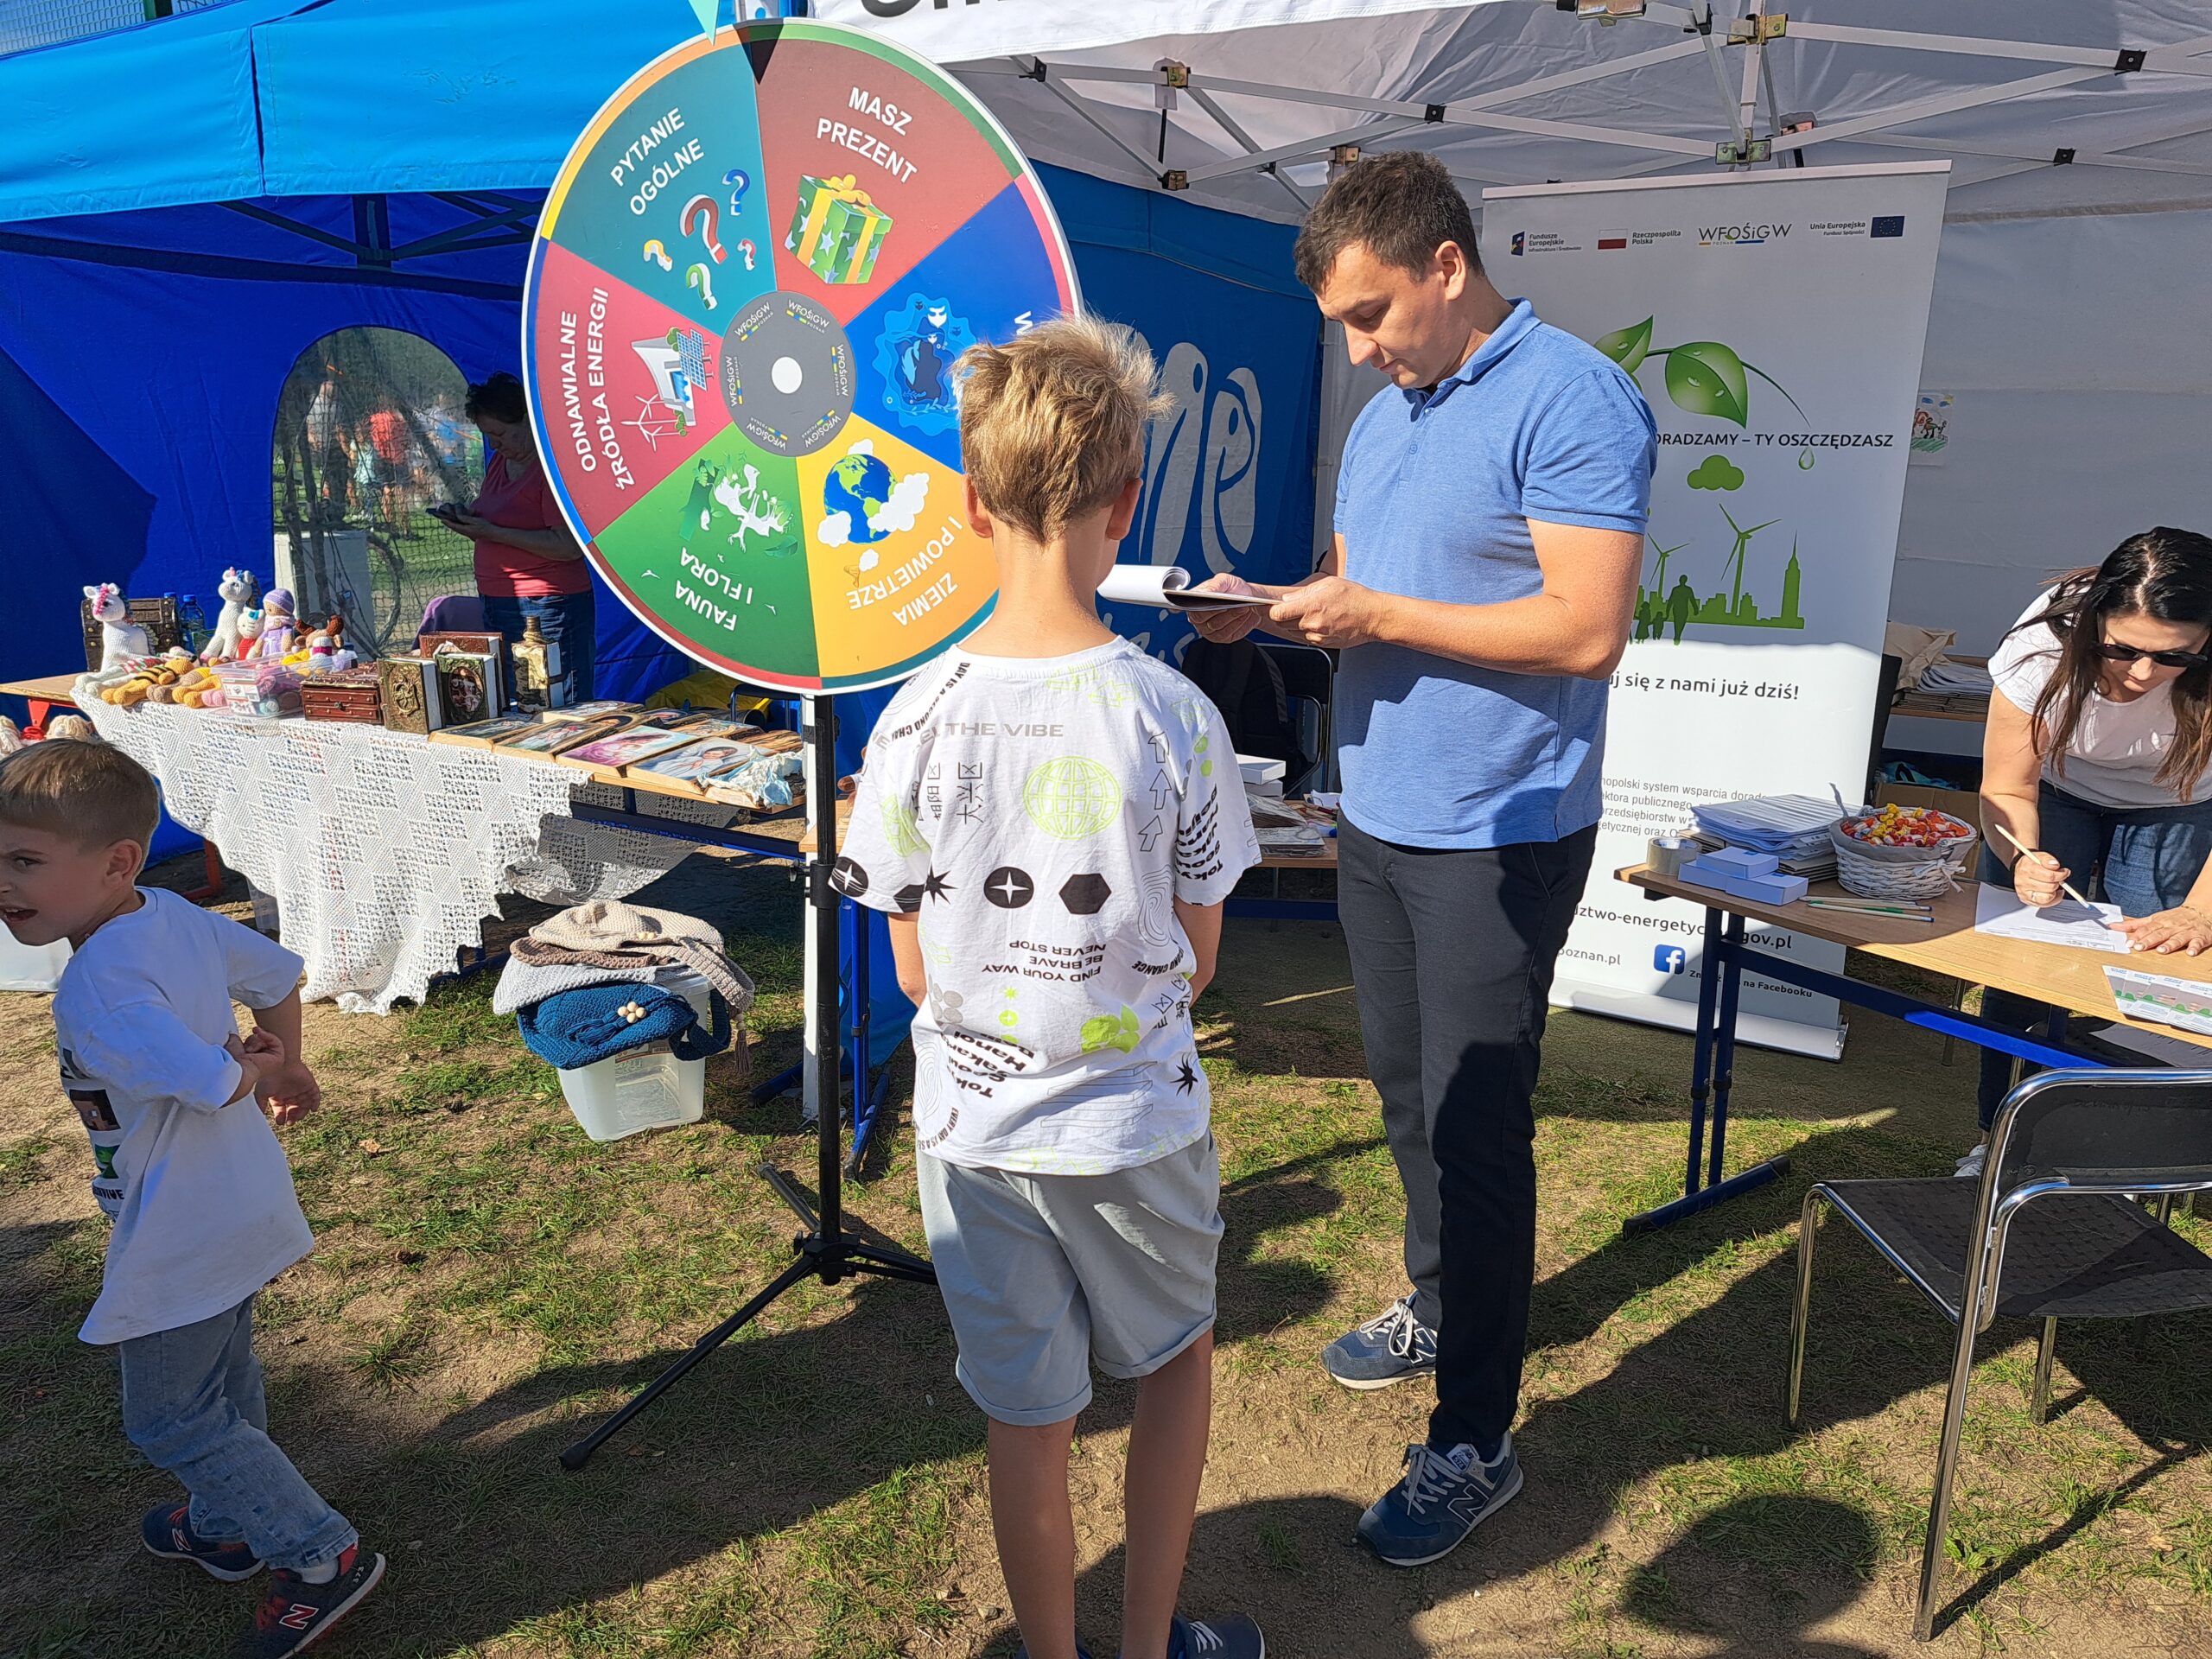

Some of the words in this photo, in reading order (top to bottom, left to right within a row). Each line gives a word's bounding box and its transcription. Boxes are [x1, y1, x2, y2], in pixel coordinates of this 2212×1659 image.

[848, 86, 913, 137] MASZ
[610, 107, 685, 187] PYTANIE
[816, 118, 918, 185] PREZENT
[630, 137, 705, 216] OGÓLNE
[1632, 230, 1681, 238] Rzeczpospolita
[1698, 222, 1793, 241] WFOŚiGW
[1827, 221, 1866, 230] Europejska
[734, 302, 771, 336] WFOŚiGW
[788, 299, 830, 328] WFOŚiGW
[587, 287, 609, 387] ENERGII
[836, 344, 849, 397] WFOŚiGW
[725, 356, 738, 407] WFOŚiGW
[560, 311, 597, 472] ODNAWIALNE
[592, 392, 635, 490] ŹRÓDŁA
[1754, 434, 1775, 446] TY
[1778, 434, 1894, 449] OSZCZĘDZASZ
[947, 516, 963, 531] I
[680, 547, 742, 601] FLORA
[846, 526, 956, 610] POWIETRZE
[746, 587, 753, 605] I
[892, 572, 959, 626] ZIEMIA
[675, 580, 738, 632] FAUNA
[1624, 672, 1650, 691] się
[1656, 678, 1665, 690] z
[1670, 678, 1715, 693] nami
[1719, 679, 1748, 696] już
[1754, 681, 1799, 700] dziś!
[945, 722, 995, 736] THE
[1004, 724, 1064, 738] VIBE
[1643, 781, 1679, 793] system
[1682, 785, 1727, 799] wsparcia
[1632, 796, 1692, 810] publicznego
[1603, 807, 1676, 823] rzedsiębiorstw
[1644, 826, 1664, 837] oraz
[1009, 940, 1047, 953] STOP
[1052, 944, 1106, 957] NEVER
[982, 964, 1019, 974] WAY
[1029, 956, 1083, 969] BRAVE
[1085, 955, 1103, 966] BE
[1023, 968, 1065, 981] YOUR
[1070, 966, 1102, 982] FIND
[1758, 982, 1813, 998] Facebooku
